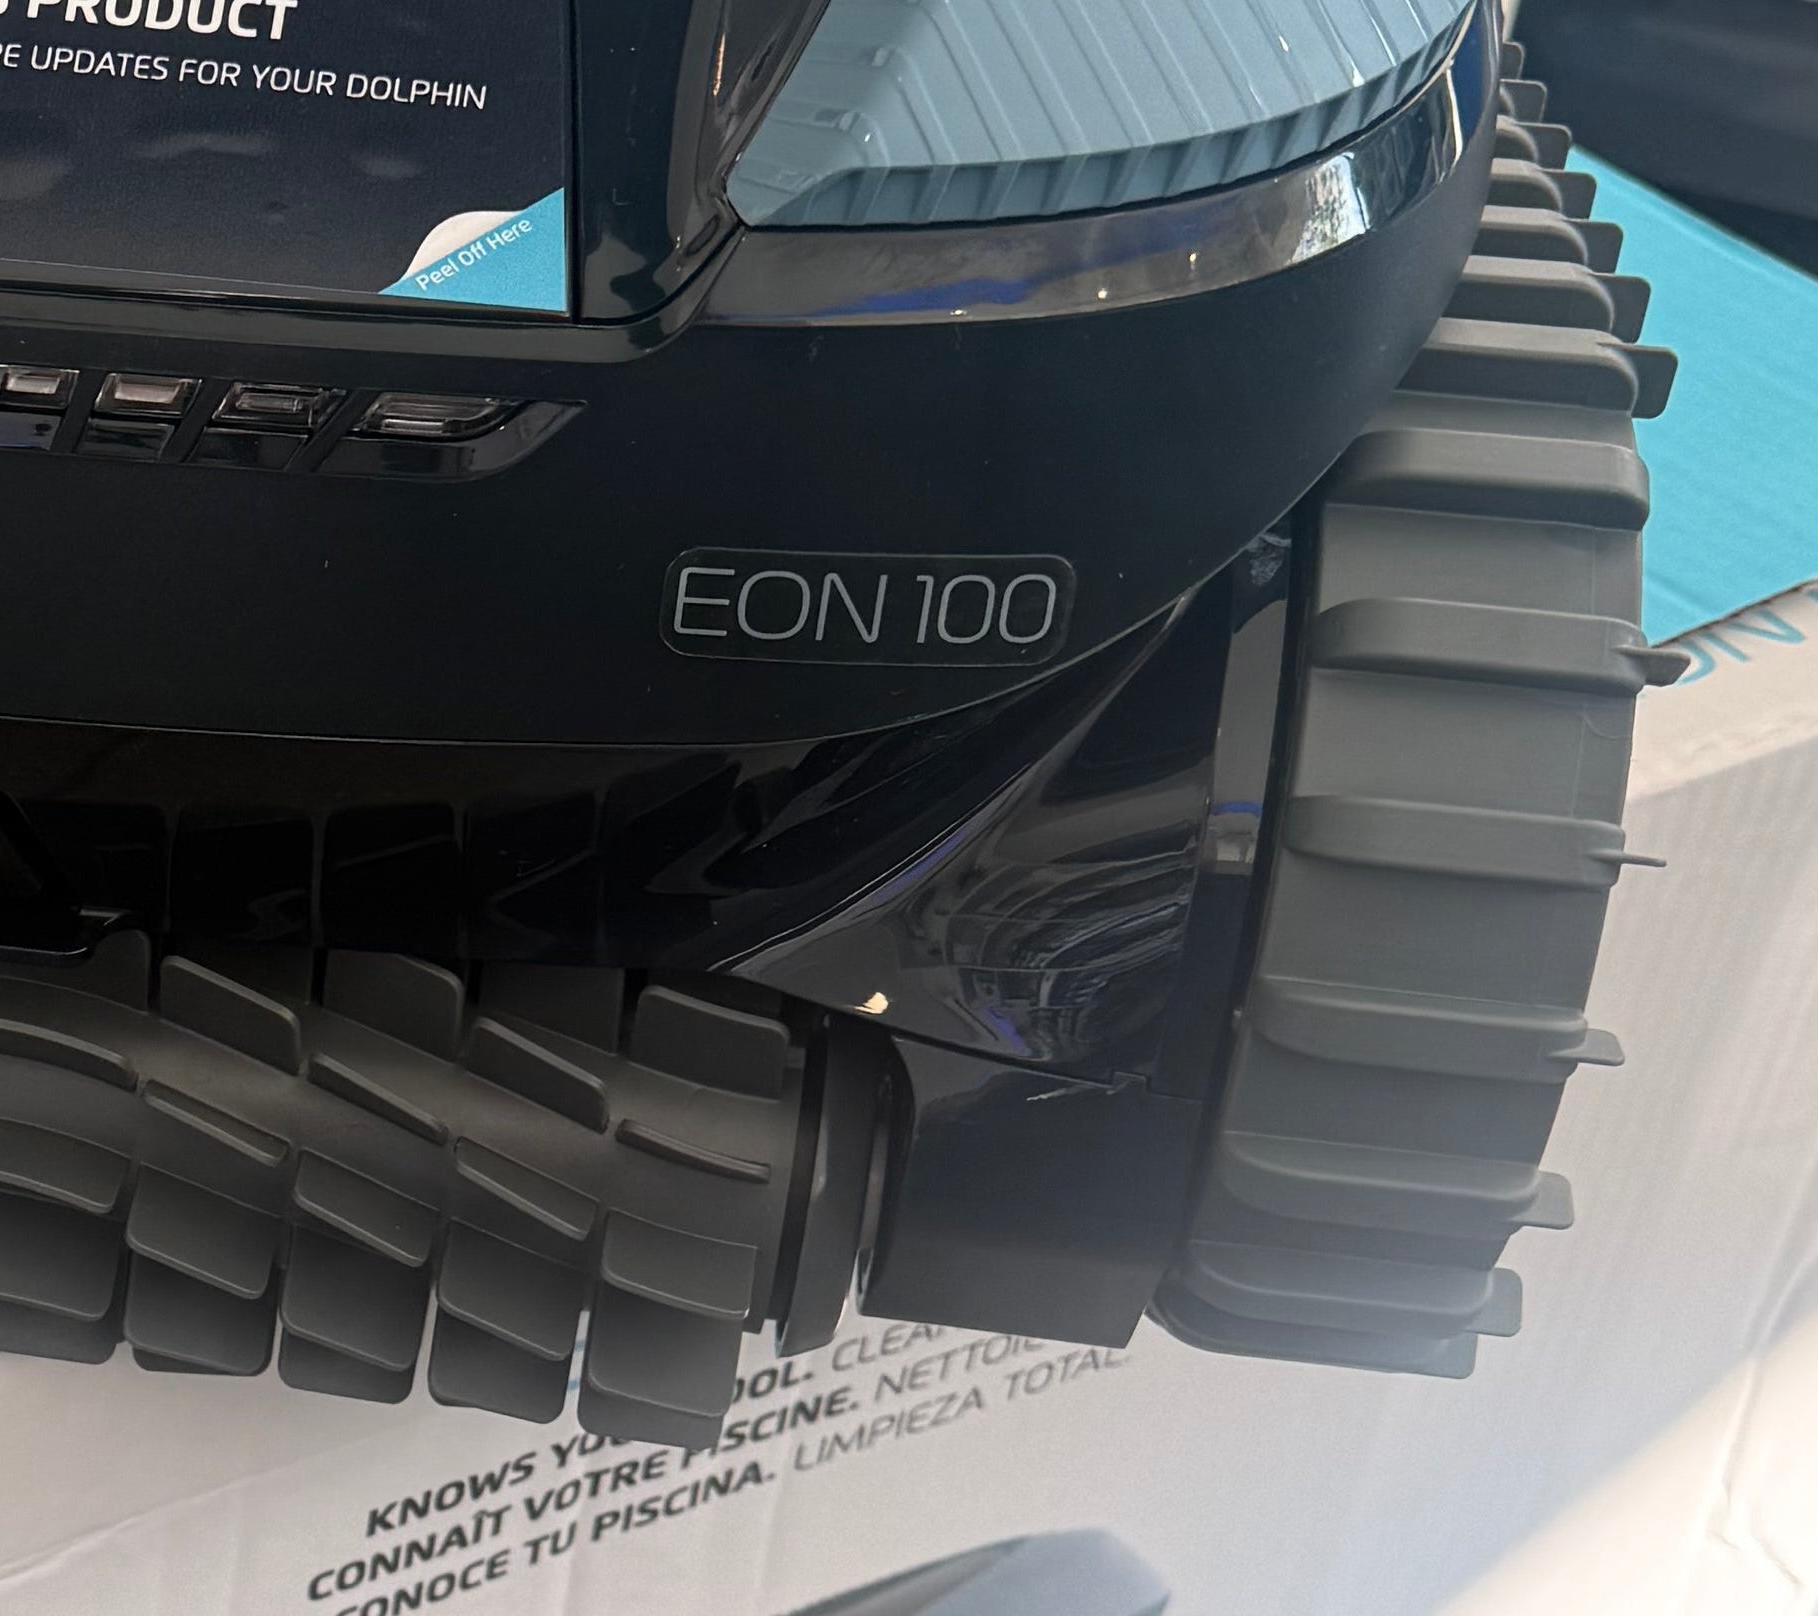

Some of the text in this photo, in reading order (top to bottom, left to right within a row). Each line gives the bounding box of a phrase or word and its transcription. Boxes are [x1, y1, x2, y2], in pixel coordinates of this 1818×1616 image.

[31, 45, 170, 81] UPDATES
[178, 59, 240, 87] FOR
[251, 64, 337, 96] YOUR
[346, 74, 487, 110] DOLPHIN
[415, 219, 533, 292] Peel Off Here
[674, 566, 1057, 644] EON 100
[365, 1452, 537, 1538] KNOWS
[525, 1523, 577, 1566] TU
[590, 1460, 777, 1542] PISCINA.
[794, 1386, 983, 1471] LIMPIEZA
[307, 1504, 511, 1601] CONNAÎT
[523, 1449, 668, 1521] VOTRE
